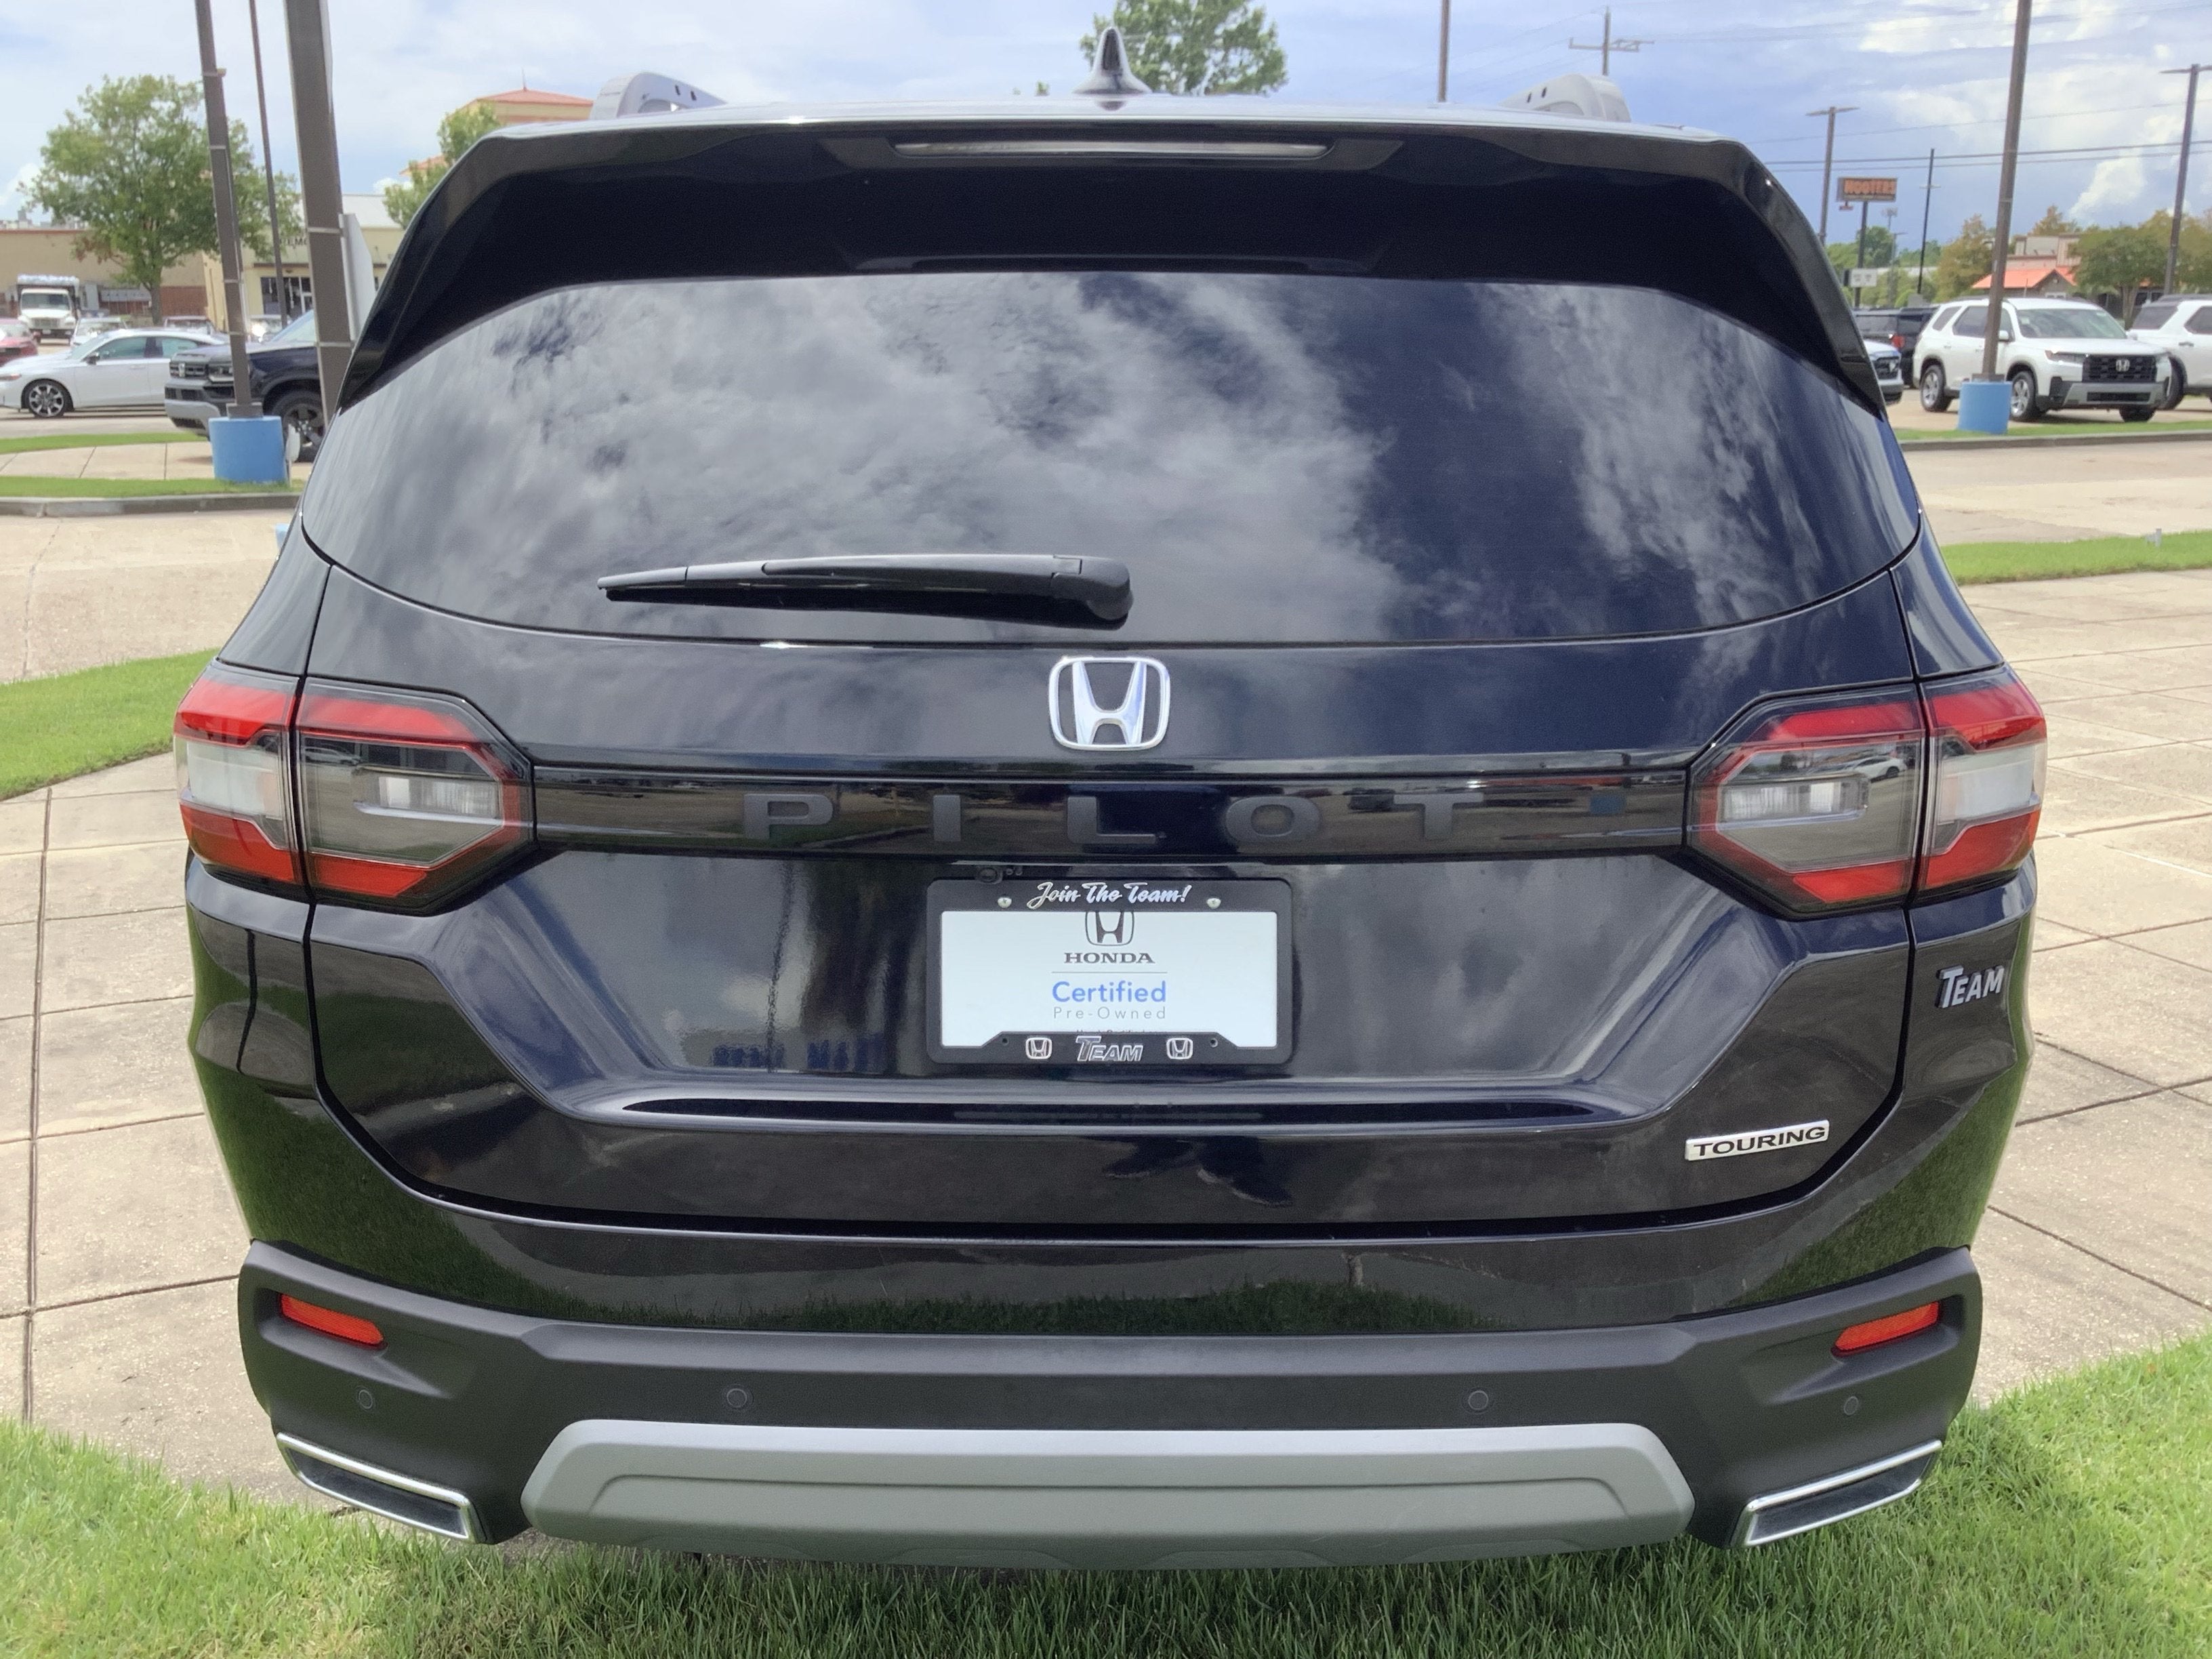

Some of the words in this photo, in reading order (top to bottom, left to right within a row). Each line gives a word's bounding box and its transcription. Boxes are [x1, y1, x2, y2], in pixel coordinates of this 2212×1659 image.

[743, 792, 1485, 846] PILOT
[1026, 881, 1081, 909] Join
[1082, 882, 1122, 904] The
[1123, 882, 1193, 904] Team!
[1063, 951, 1156, 964] HONDA
[1051, 979, 1167, 1003] Certified
[1936, 965, 2005, 1009] TEAM
[1052, 1006, 1166, 1019] Pre-Owned
[1075, 1035, 1144, 1062] TEAM
[1693, 1126, 1826, 1157] TOURING
